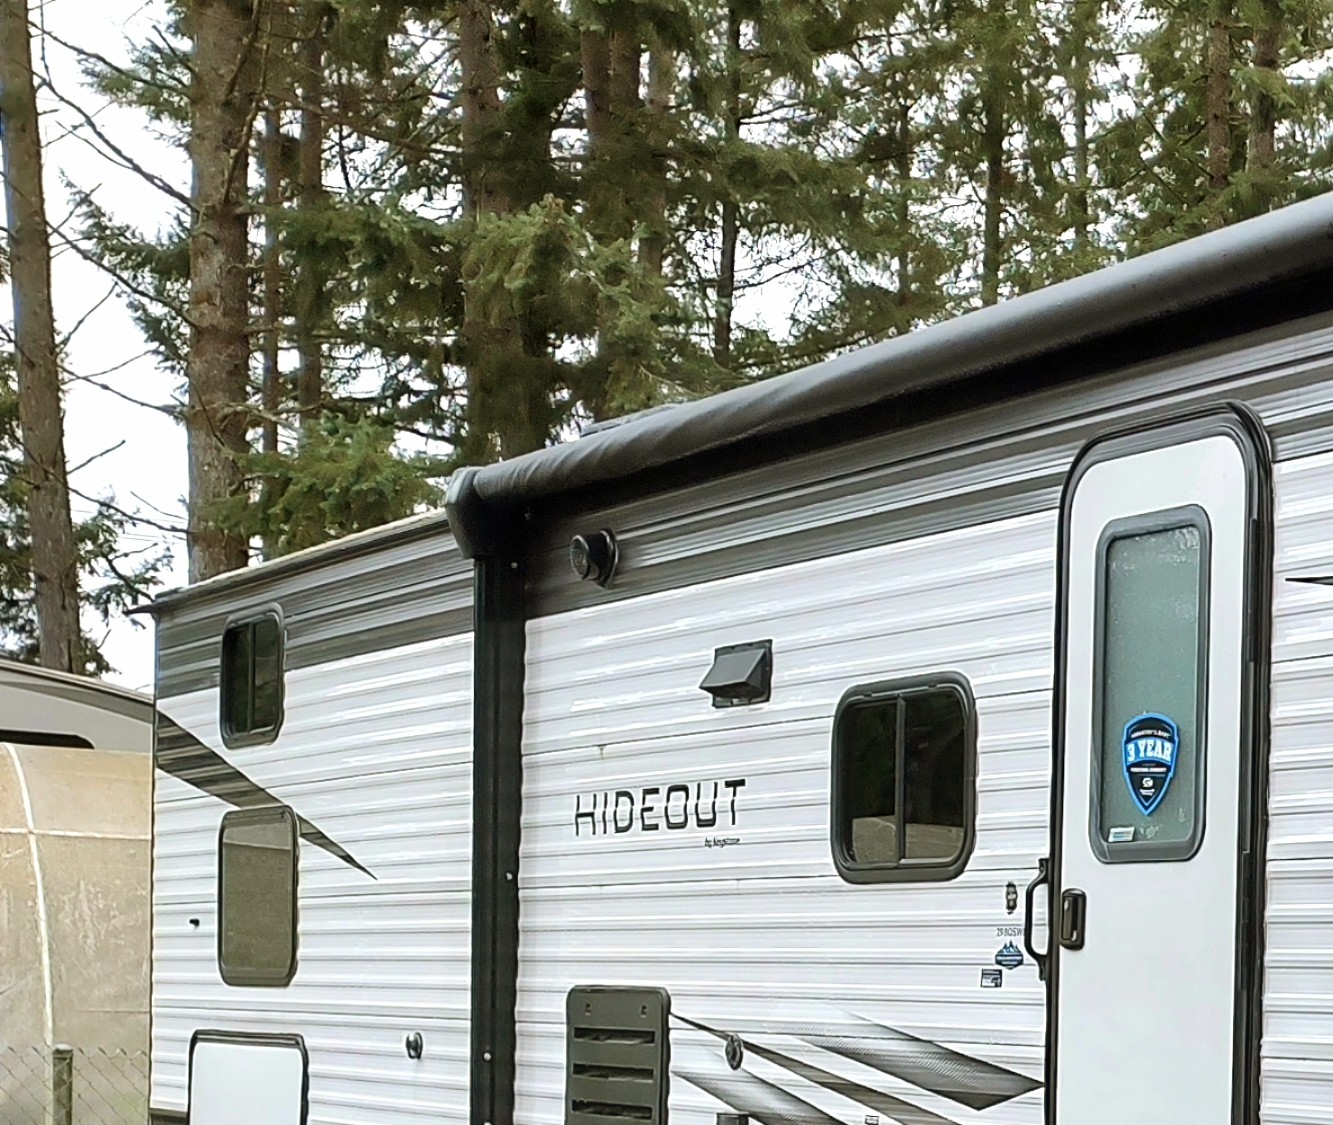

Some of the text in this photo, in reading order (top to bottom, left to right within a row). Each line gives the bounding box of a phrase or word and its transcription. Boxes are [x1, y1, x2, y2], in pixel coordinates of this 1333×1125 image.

[1127, 739, 1172, 763] 3 YEAR
[575, 778, 746, 837] HIDEOUT
